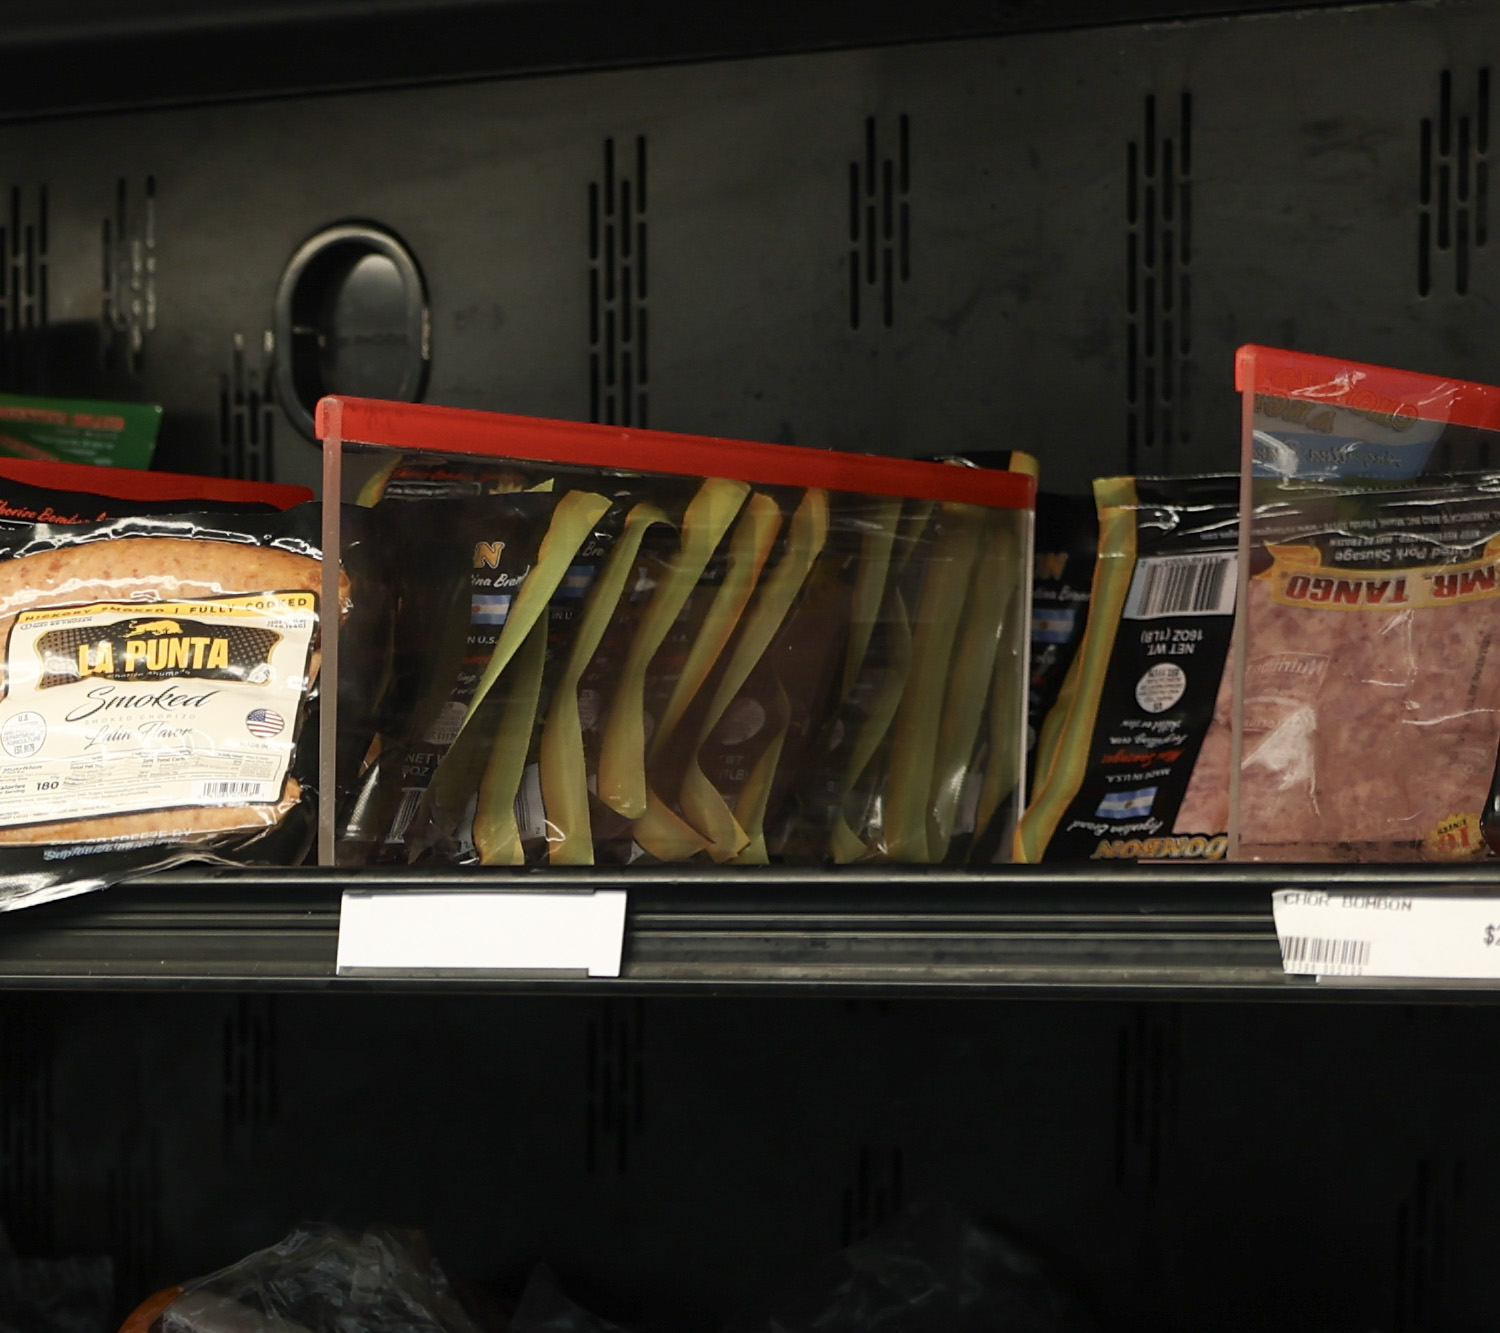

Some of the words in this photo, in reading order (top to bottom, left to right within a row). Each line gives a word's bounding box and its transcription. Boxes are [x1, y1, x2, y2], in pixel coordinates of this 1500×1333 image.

[1285, 573, 1410, 605] TANGO
[189, 603, 235, 615] FULLY
[244, 597, 308, 613] COOKED
[78, 642, 116, 678] LA
[124, 636, 231, 675] PUNTA
[64, 686, 222, 723] Smoked
[35, 780, 60, 792] 180
[1341, 894, 1413, 912] BOMBON
